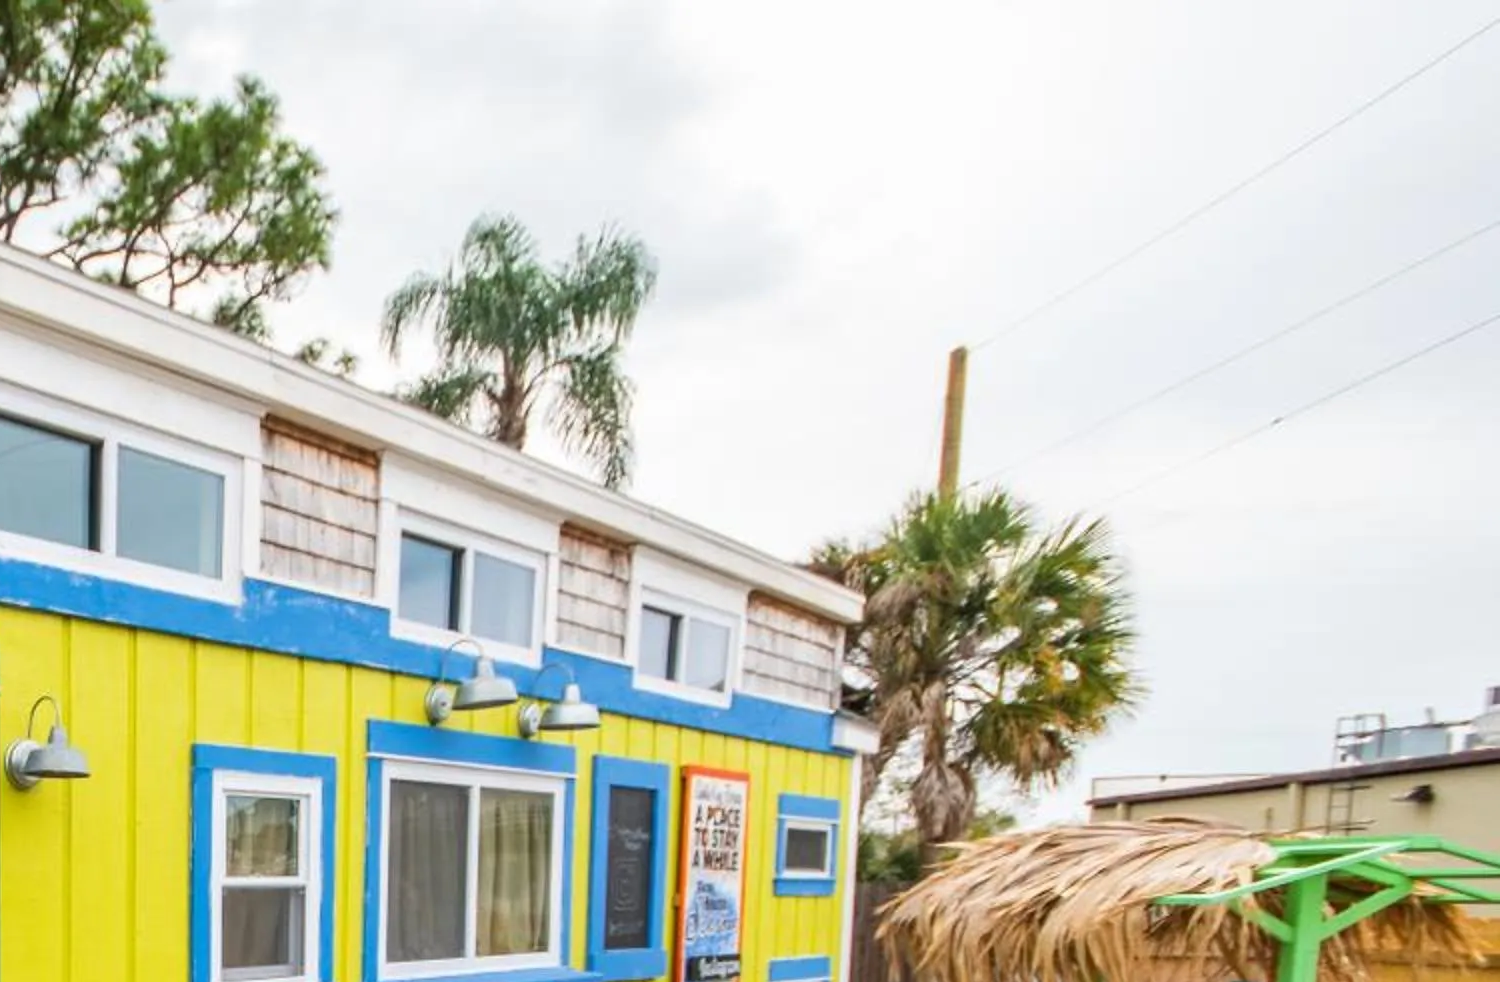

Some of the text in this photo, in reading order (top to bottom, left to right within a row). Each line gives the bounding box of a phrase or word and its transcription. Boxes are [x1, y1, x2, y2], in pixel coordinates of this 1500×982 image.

[695, 804, 740, 828] A PLACE
[694, 827, 738, 849] TO STAY
[692, 849, 738, 871] A WHILE
